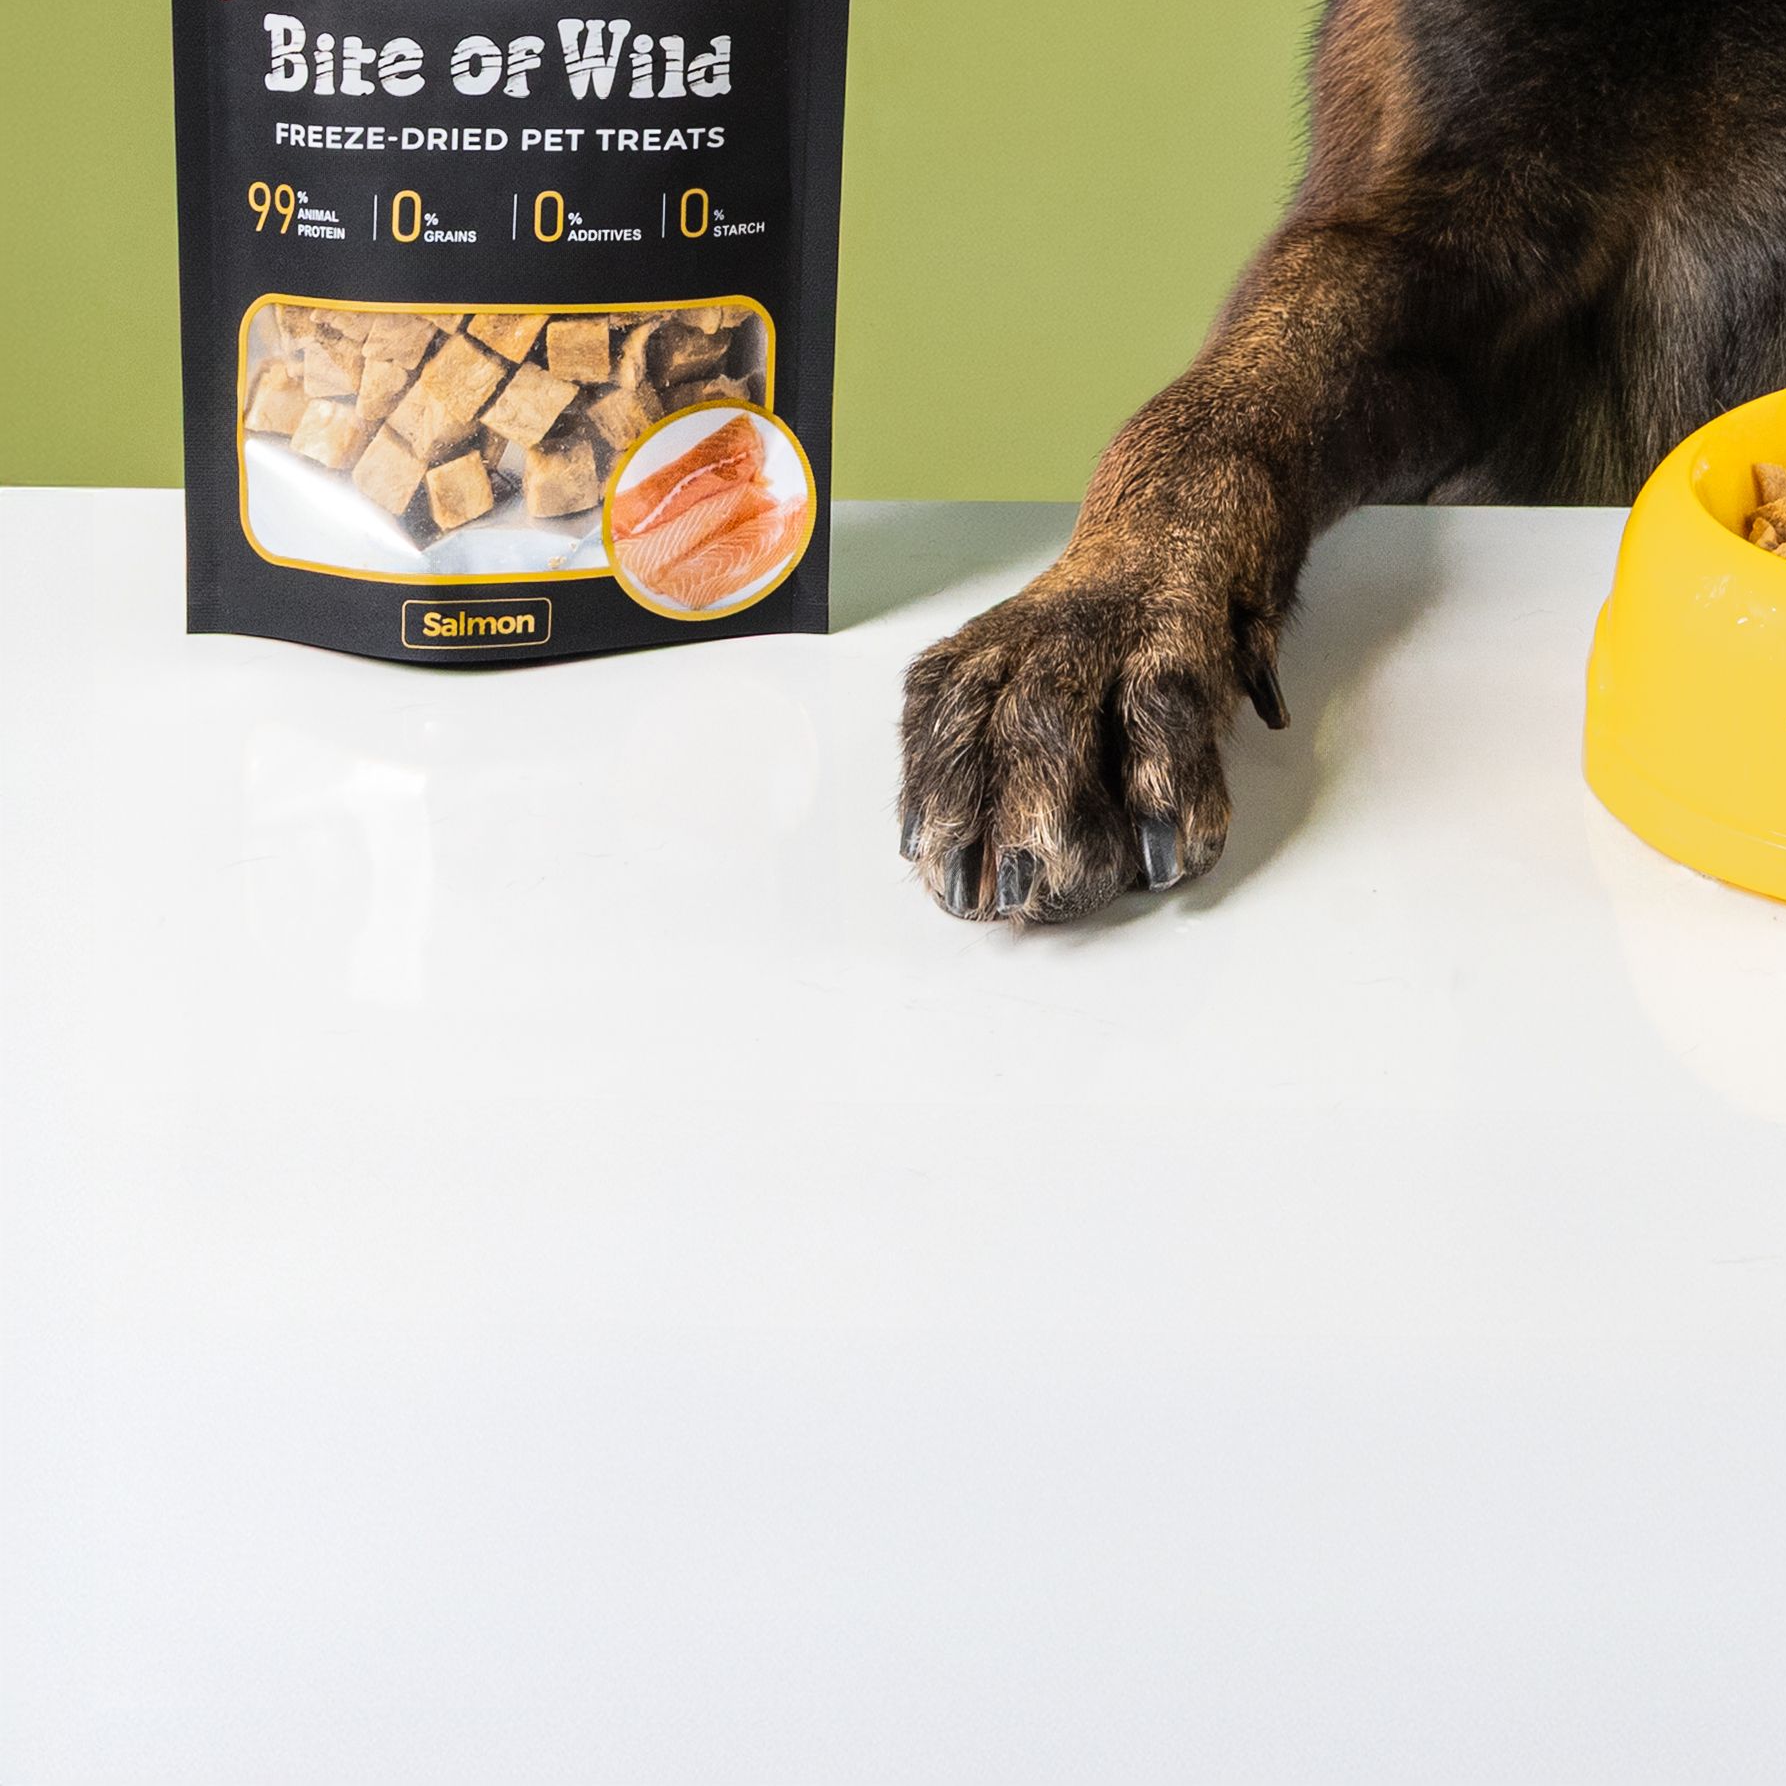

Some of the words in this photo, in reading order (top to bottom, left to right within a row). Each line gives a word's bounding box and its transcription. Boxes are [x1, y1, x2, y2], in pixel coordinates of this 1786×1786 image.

[263, 12, 426, 98] Bite
[557, 18, 733, 101] Wild
[275, 122, 509, 152] FREEZE-DRIED
[521, 128, 585, 153] PET
[595, 126, 726, 152] TREATS
[247, 180, 297, 235] 99
[296, 207, 341, 224] ANIMAL
[297, 223, 346, 241] PROTEIN
[423, 229, 478, 244] GRAINS
[566, 228, 643, 243] ADDITIVES
[712, 221, 766, 238] STARCH
[421, 610, 536, 638] Salmon
